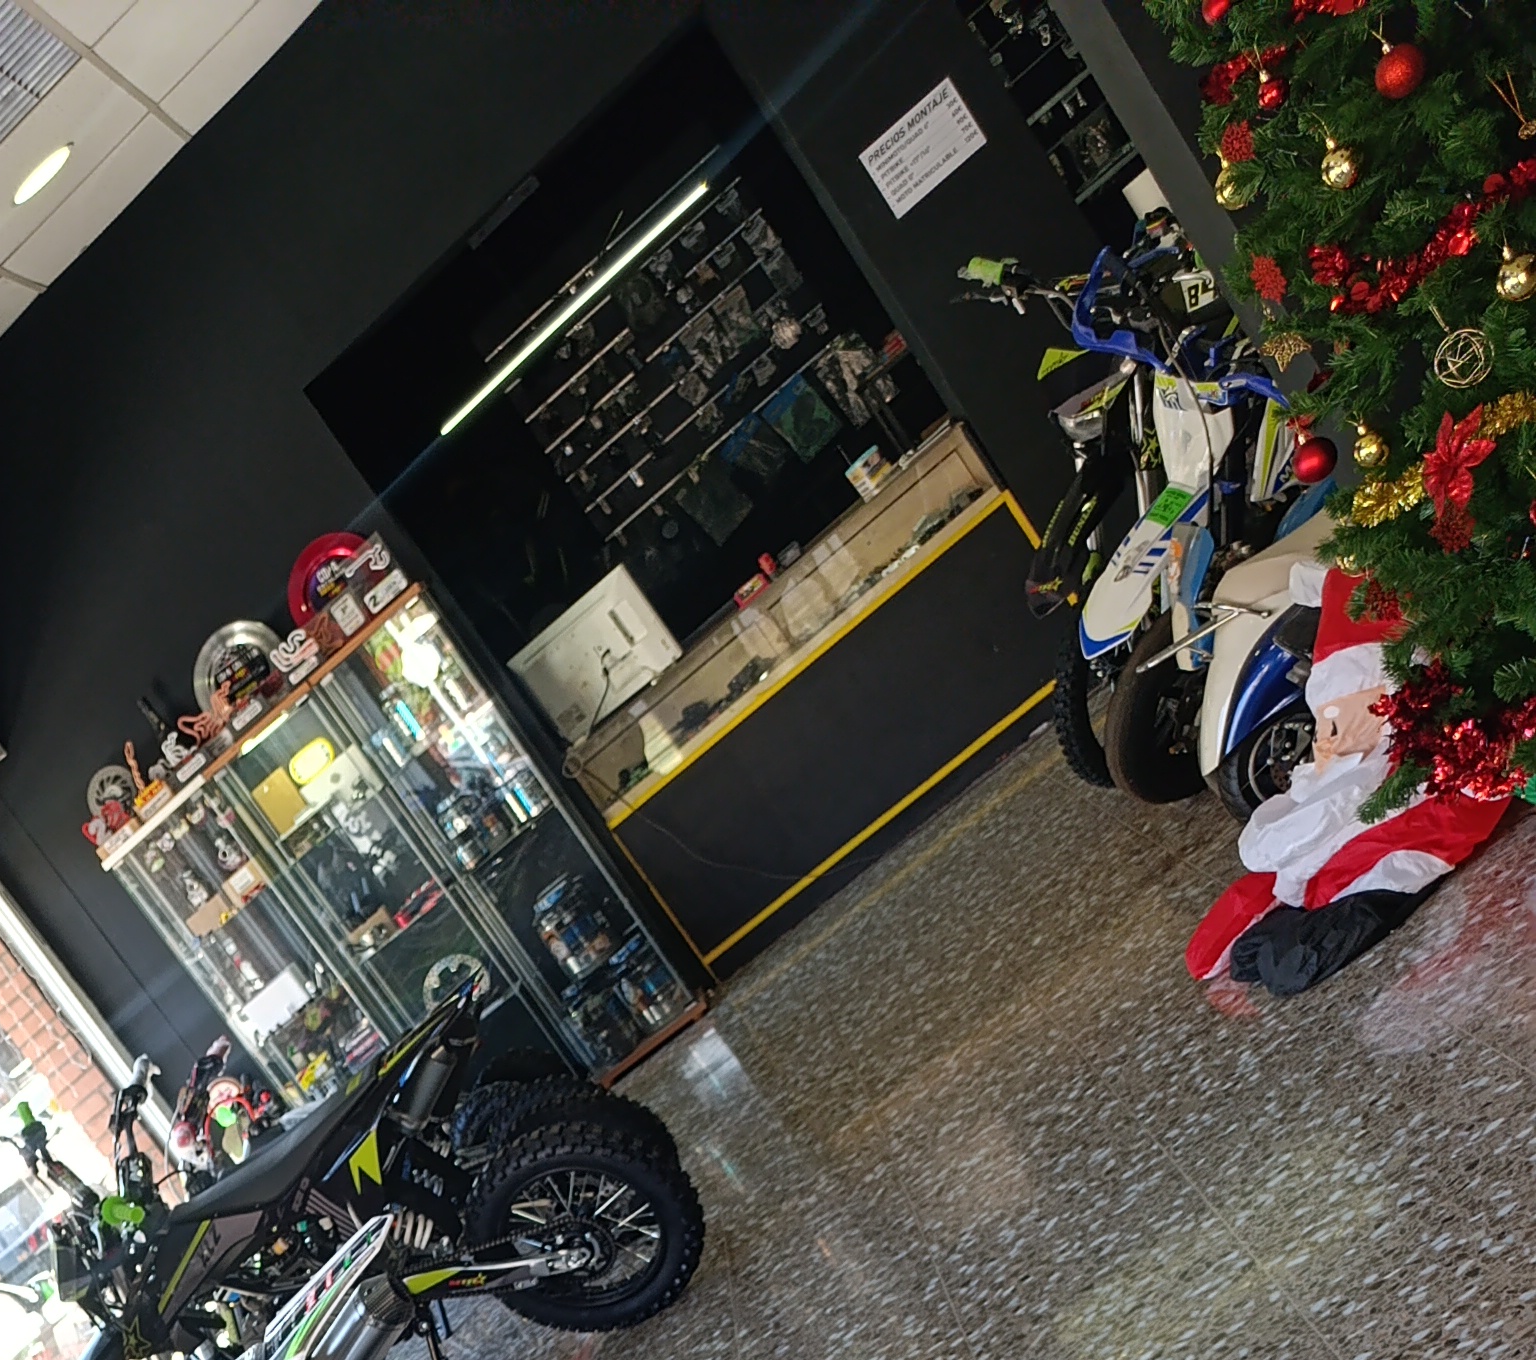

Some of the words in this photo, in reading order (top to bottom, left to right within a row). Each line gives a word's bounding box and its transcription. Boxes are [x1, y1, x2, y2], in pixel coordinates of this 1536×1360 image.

[868, 128, 905, 166] PRECIOS
[907, 88, 950, 131] MONTAJE
[912, 147, 958, 189] MATRICULABLE
